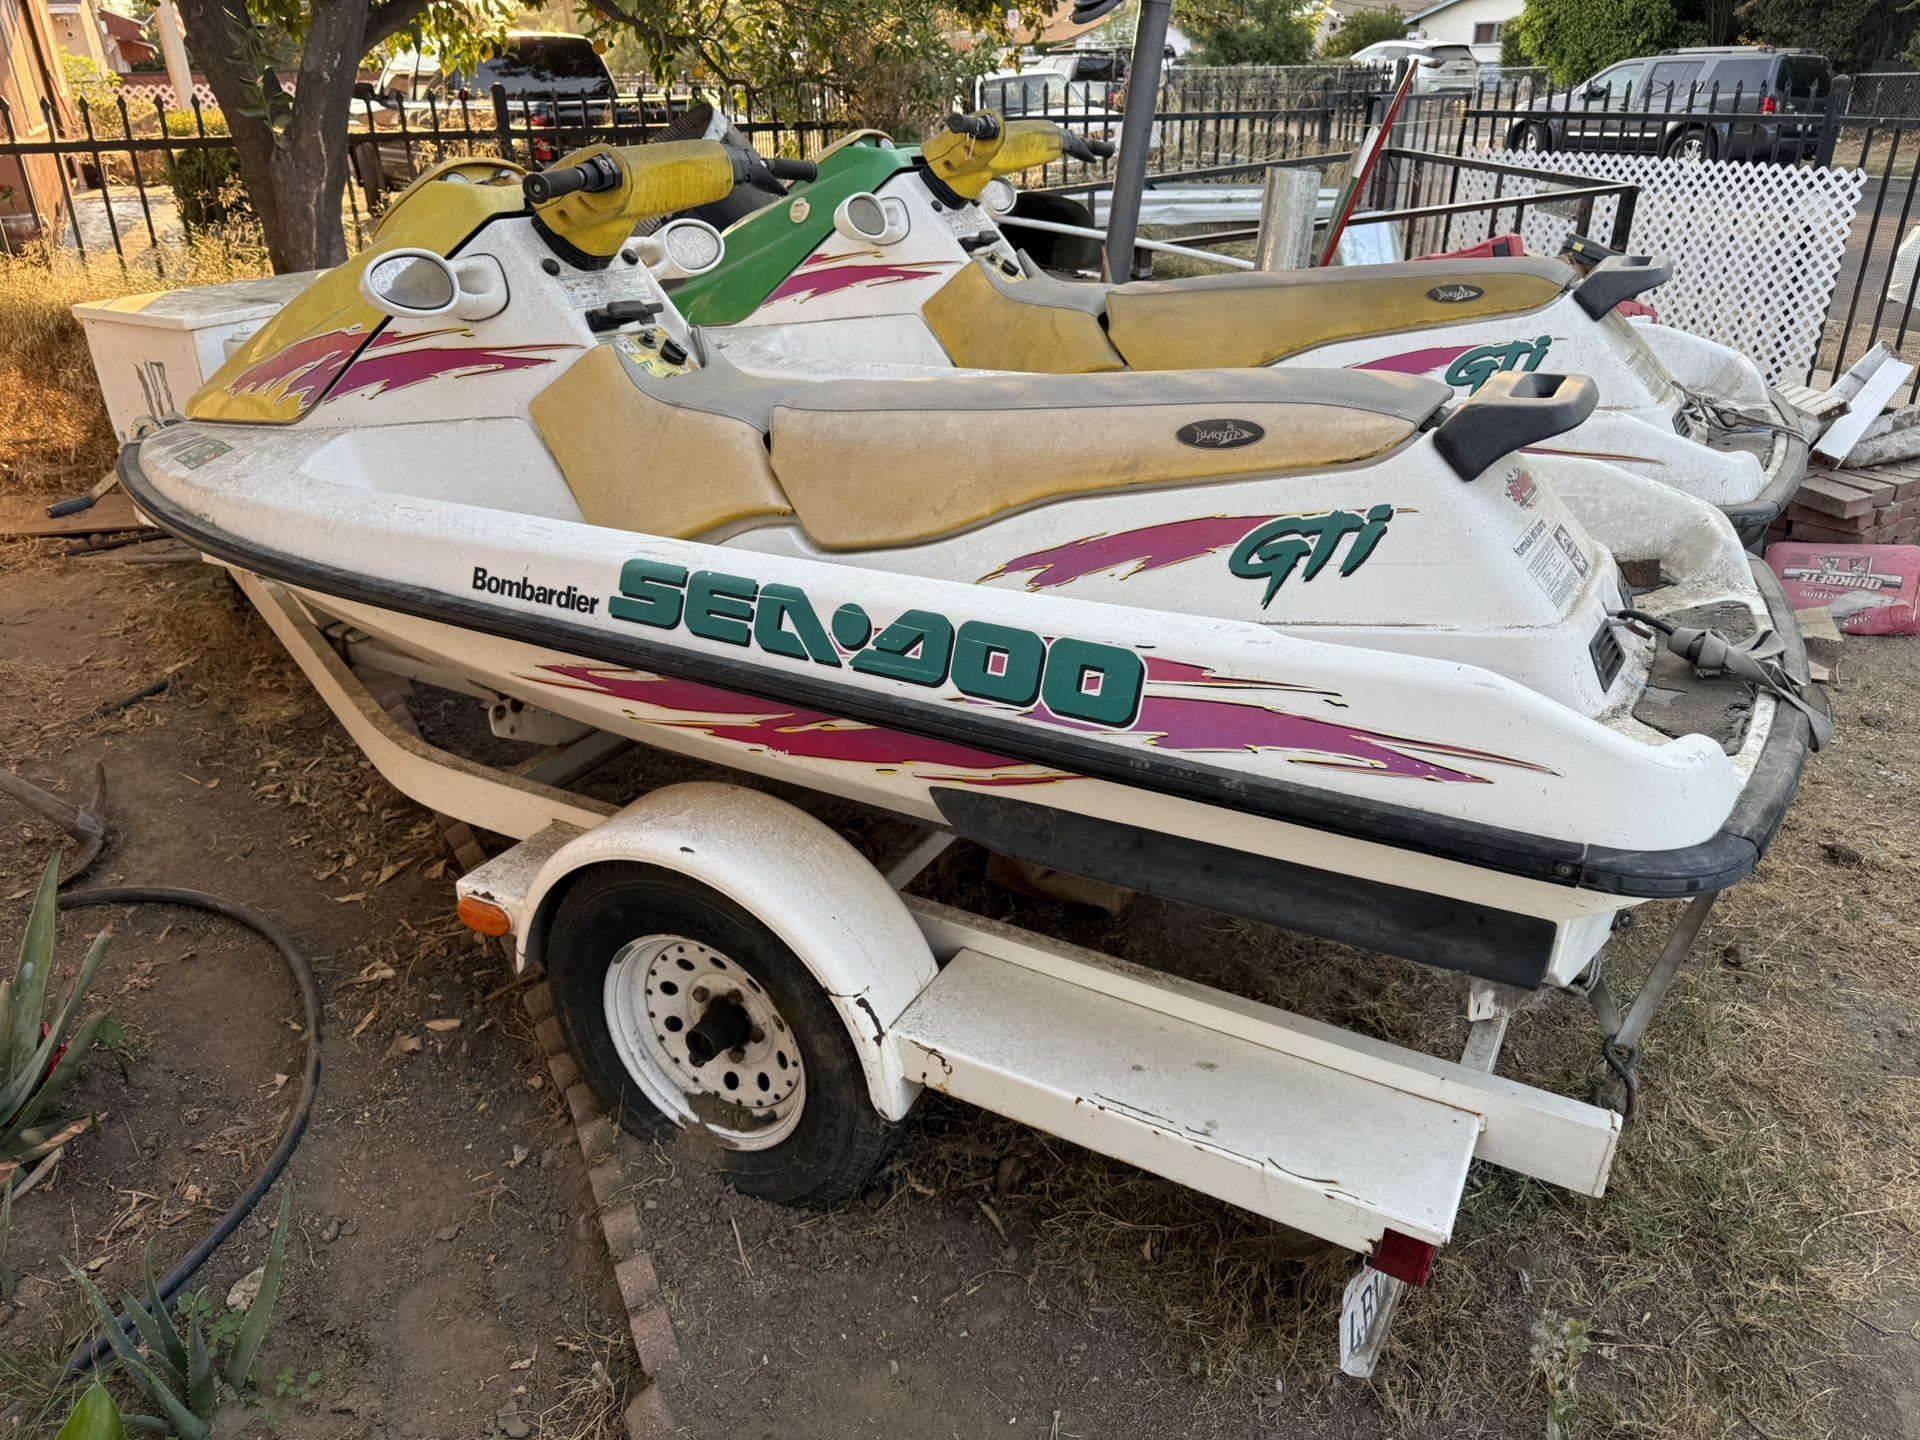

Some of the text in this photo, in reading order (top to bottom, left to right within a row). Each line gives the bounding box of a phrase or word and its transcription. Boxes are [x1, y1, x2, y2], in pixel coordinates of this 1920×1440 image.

[1512, 535, 1534, 558] formula
[472, 566, 600, 614] Bombardier
[1800, 571, 1884, 591] QUIKRETE
